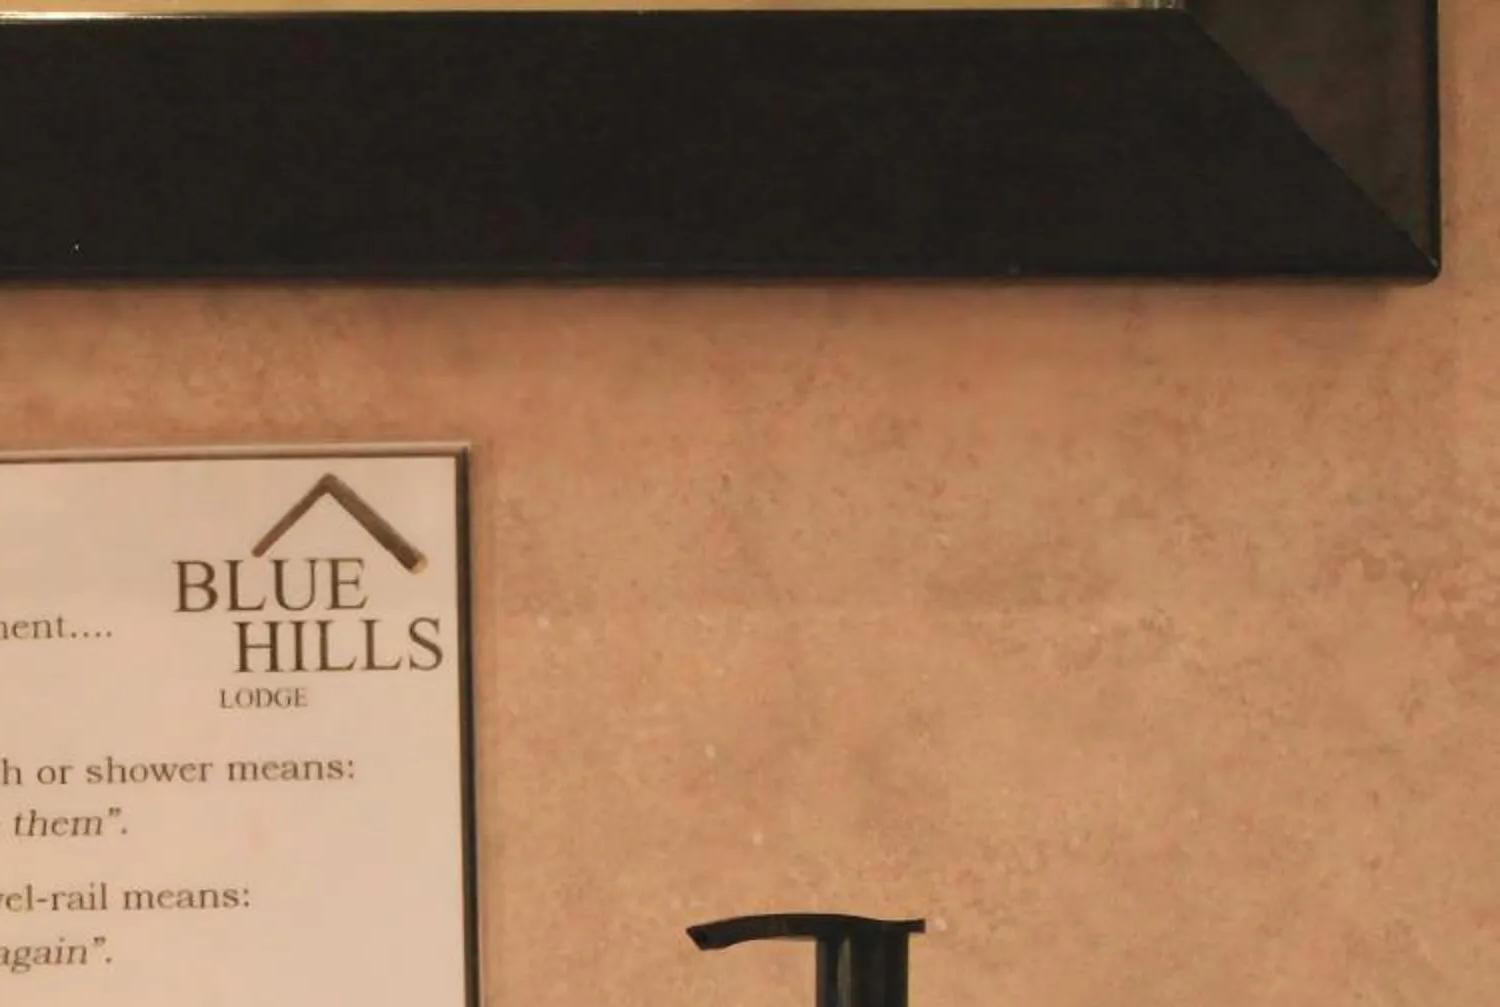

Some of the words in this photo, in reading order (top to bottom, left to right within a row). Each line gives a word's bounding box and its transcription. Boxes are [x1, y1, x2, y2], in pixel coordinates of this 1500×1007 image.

[172, 556, 369, 613] BLUE
[232, 615, 444, 673] HILLS
[218, 686, 309, 709] LODGE
[36, 764, 74, 785] or
[85, 755, 214, 785] shower
[227, 758, 356, 783] means:
[13, 806, 129, 838] them”.
[122, 886, 251, 911] means:
